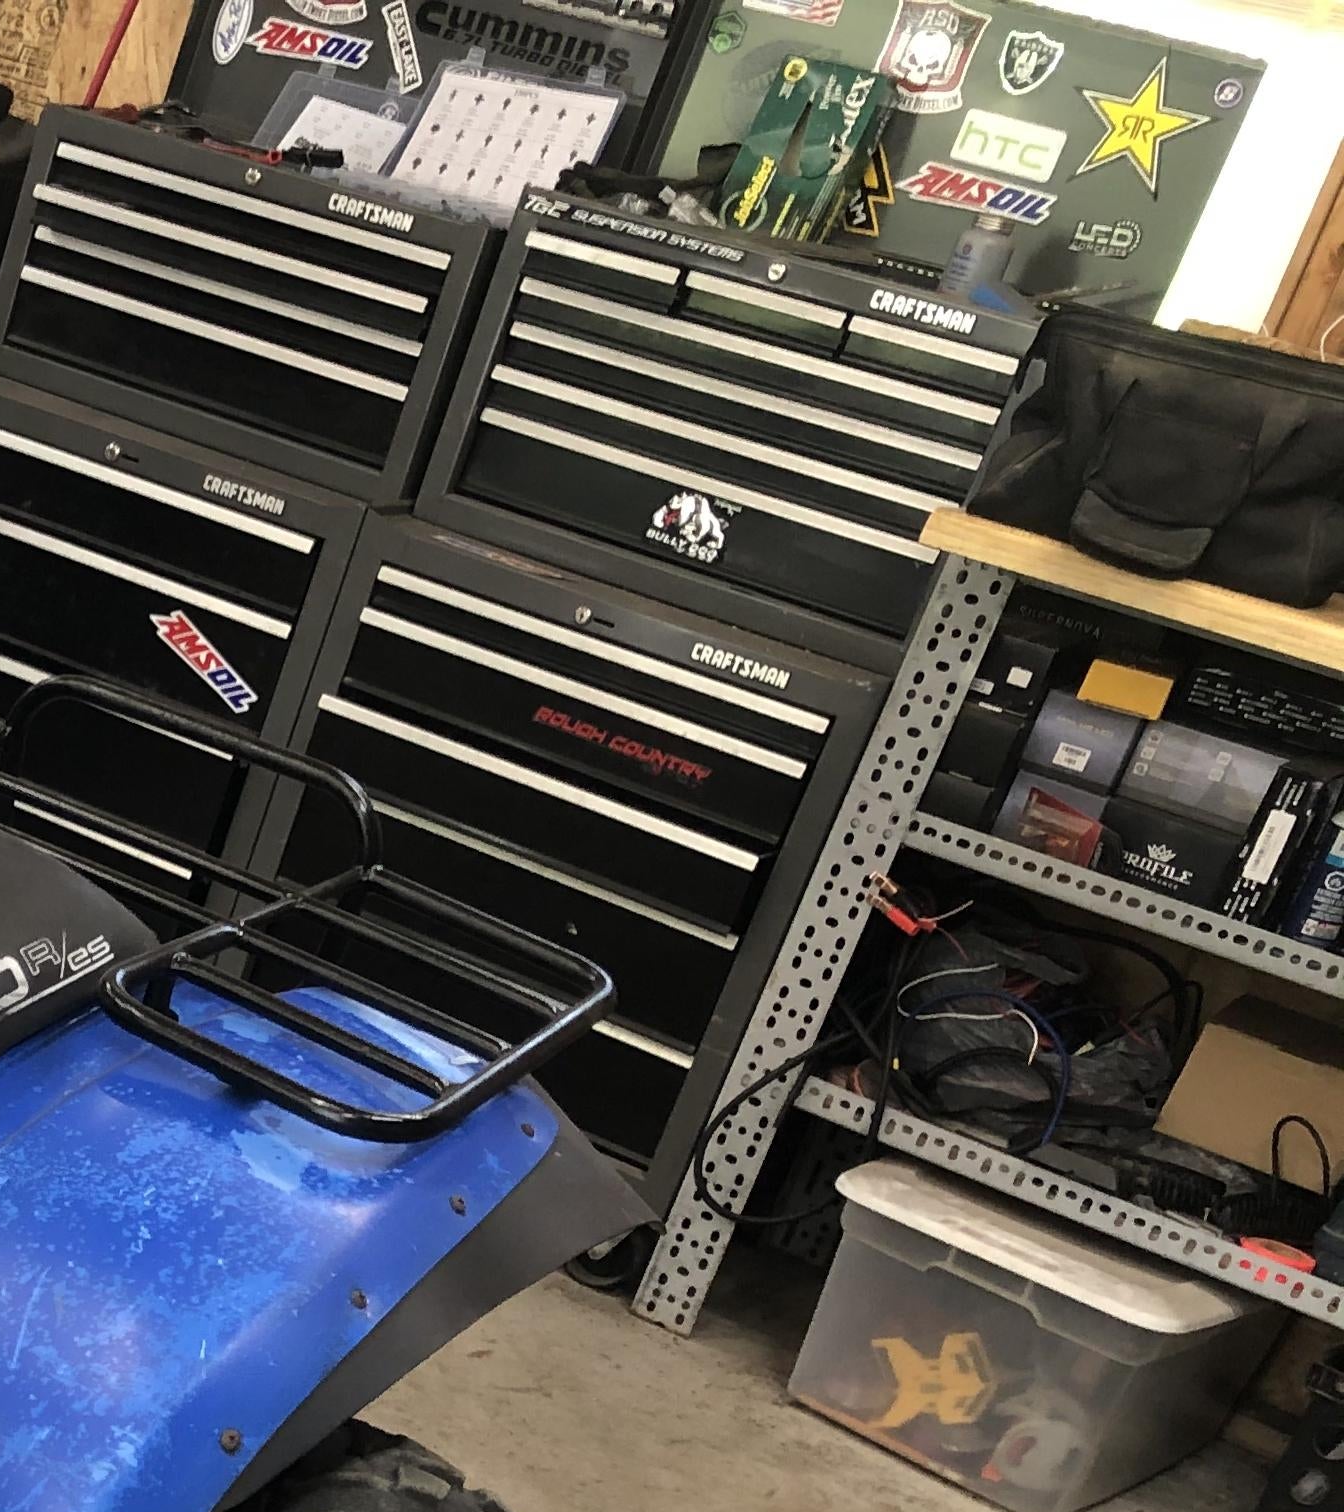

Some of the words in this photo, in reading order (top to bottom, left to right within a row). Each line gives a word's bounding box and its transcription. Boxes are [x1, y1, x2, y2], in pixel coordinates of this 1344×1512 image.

[254, 21, 366, 64] AMSOIL
[490, 38, 556, 67] TURBO
[556, 59, 624, 86] DIEEL
[328, 193, 414, 233] CRAFTSMAN
[906, 165, 1050, 220] AMSOIL
[571, 209, 668, 242] SUSPENSION
[667, 233, 745, 263] SYSTEMS
[869, 289, 976, 334] CRAFTSMAN
[202, 474, 285, 515] CRAFTSMAN
[158, 614, 252, 709] AMSOIL
[691, 643, 791, 690] CRAFTSMAN
[533, 706, 608, 743] ROUGH
[608, 735, 712, 780] COUNTRY
